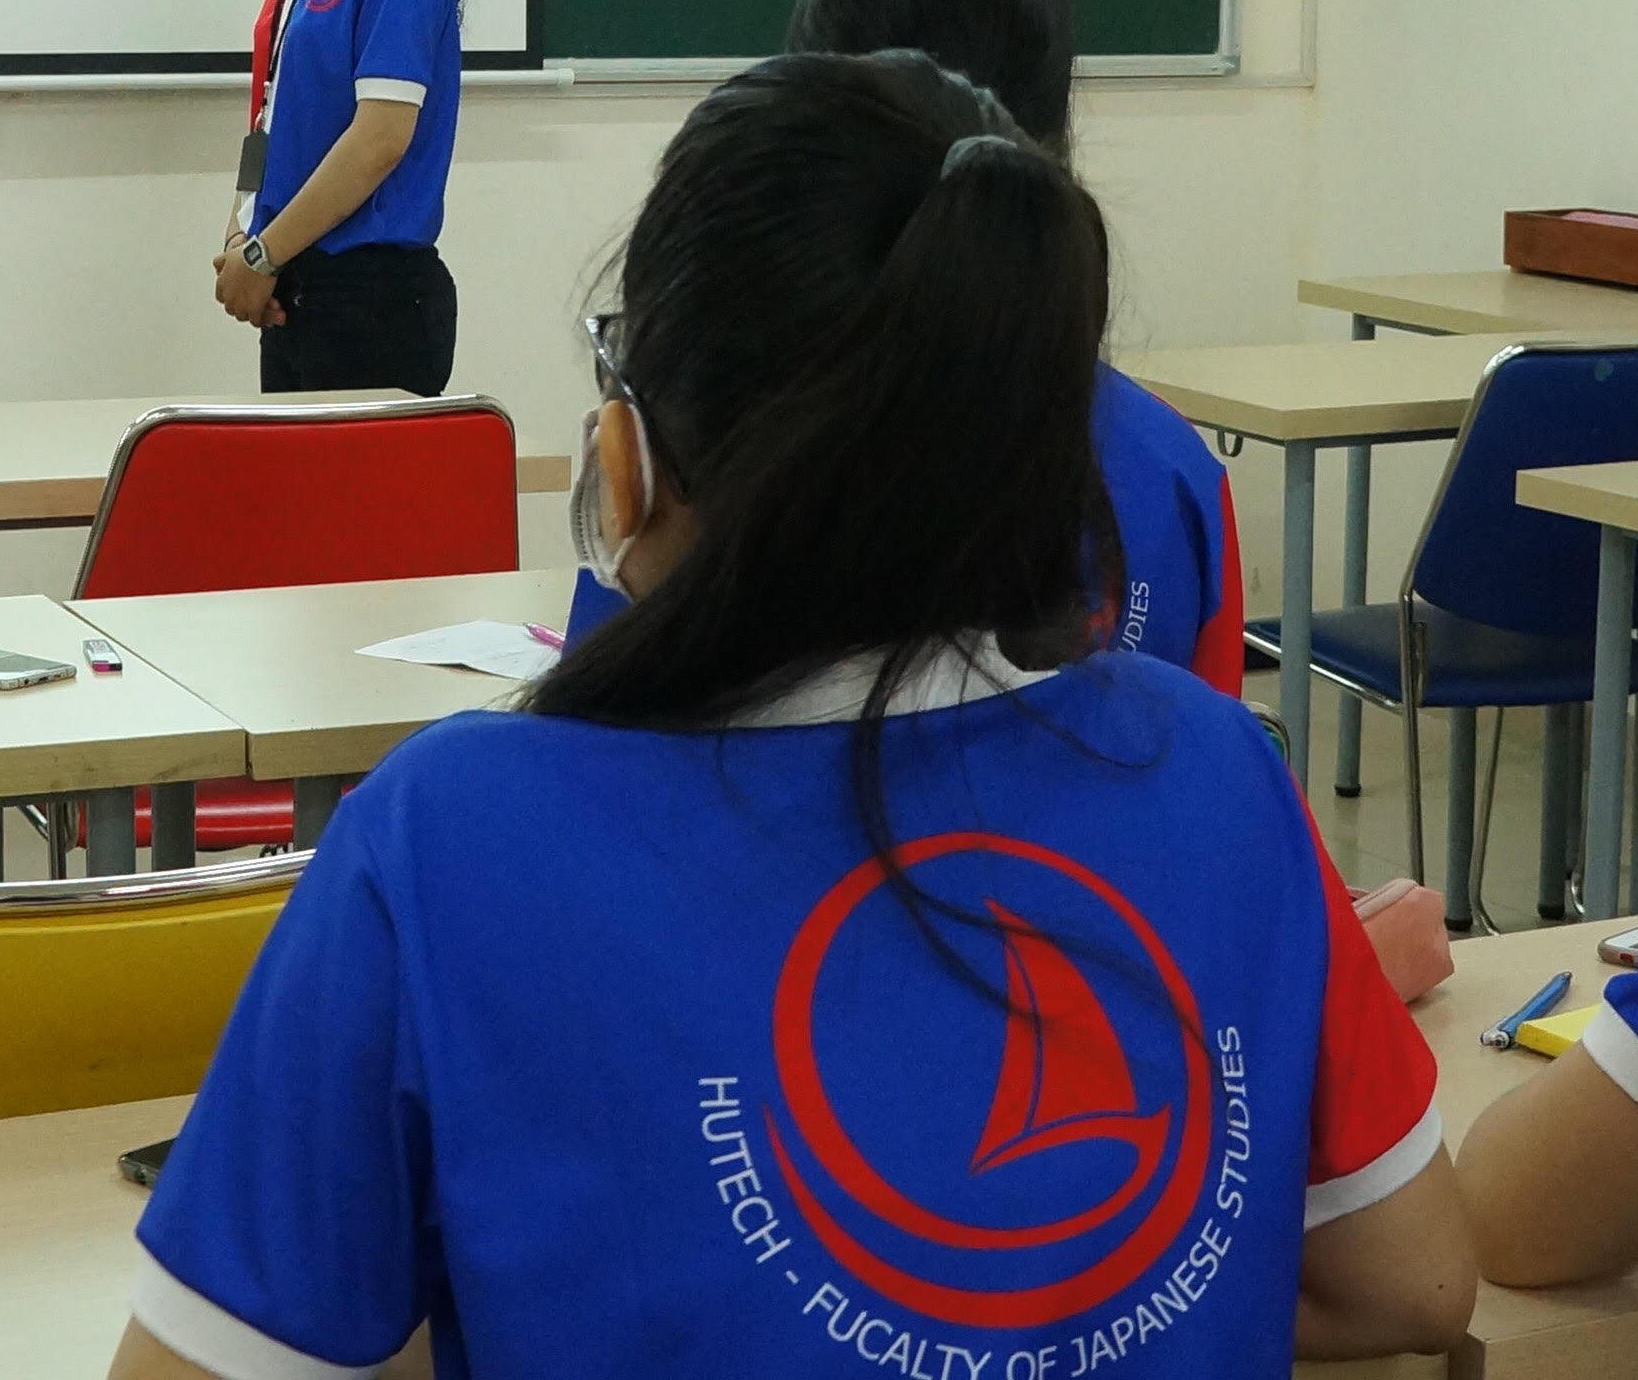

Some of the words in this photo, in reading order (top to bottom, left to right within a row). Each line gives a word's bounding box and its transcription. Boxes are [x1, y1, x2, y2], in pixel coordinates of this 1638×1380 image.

[1117, 581, 1150, 653] UDIES
[698, 1076, 792, 1264] HUTECH
[802, 1281, 993, 1380] FUCALTY
[1005, 1345, 1058, 1380] OF
[1069, 1218, 1234, 1378] JAPANESE
[1216, 1025, 1251, 1220] STUDIES
